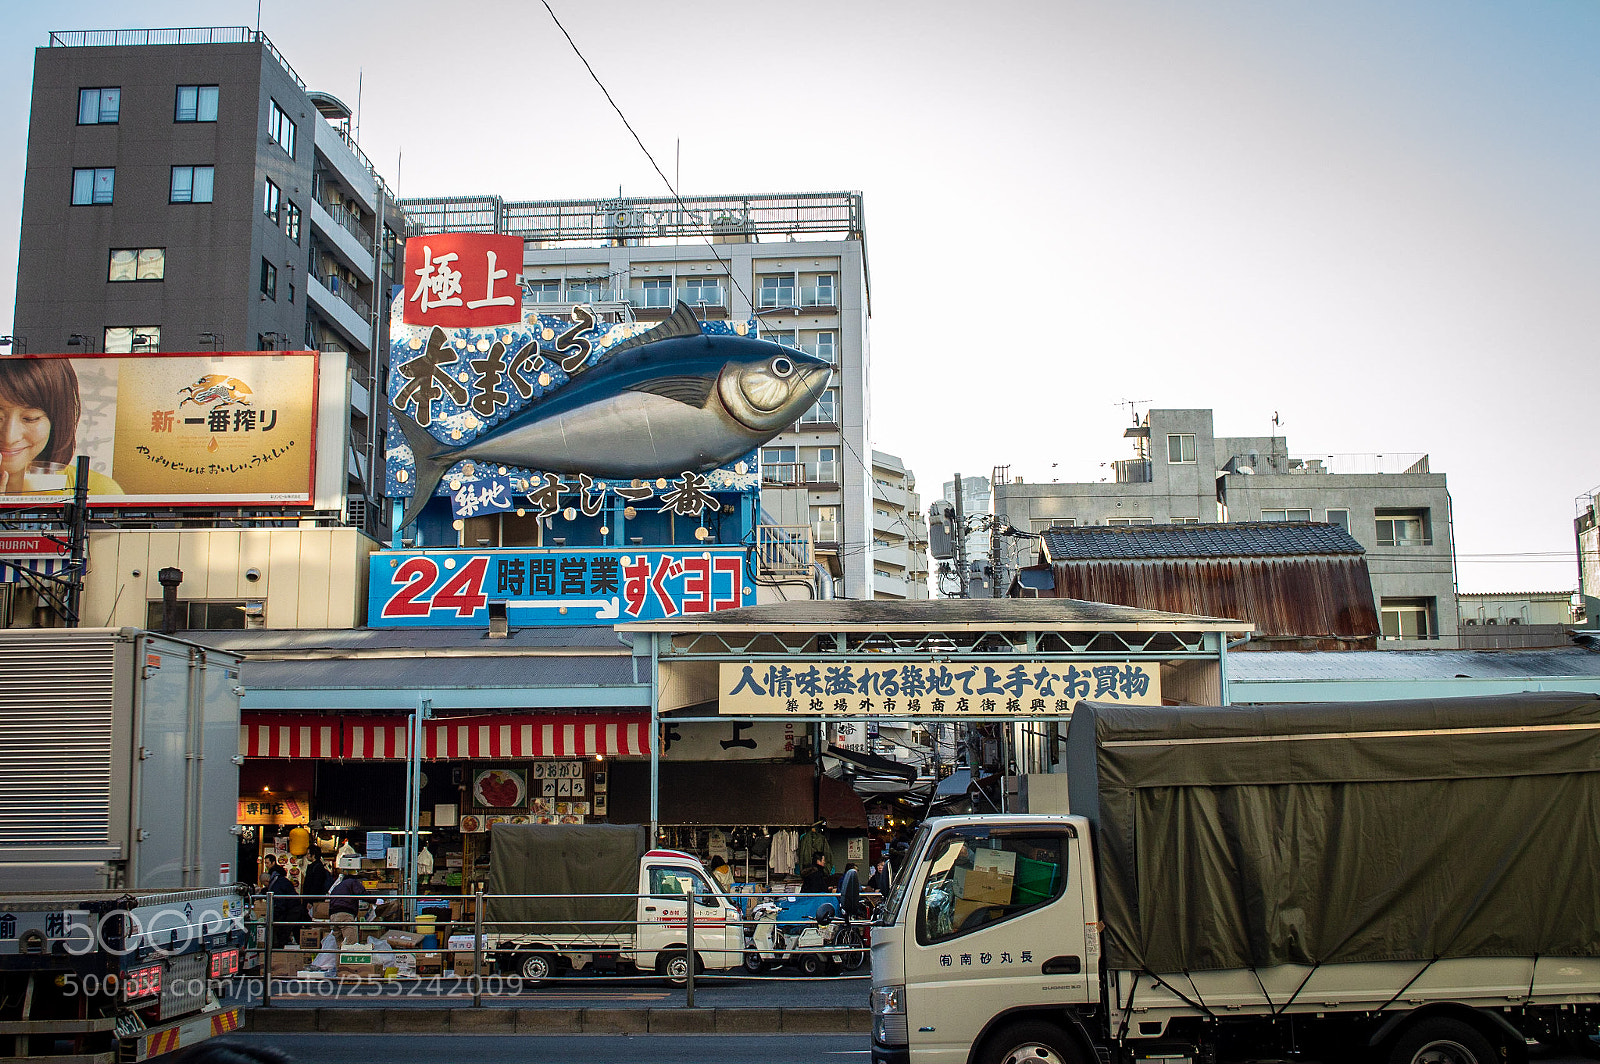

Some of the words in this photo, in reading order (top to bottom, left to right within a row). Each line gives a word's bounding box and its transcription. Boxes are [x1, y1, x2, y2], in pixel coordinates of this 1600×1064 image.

[409, 244, 515, 313] 極上
[393, 304, 598, 427] 本まぐろ
[151, 409, 278, 433] 新・一番搾り
[454, 480, 512, 518] 築地
[528, 471, 720, 518] すし一番
[728, 665, 1150, 698] 人情味溢れる築地で上手なお買物
[785, 698, 1087, 712] 築地場外市場商店街振興組
